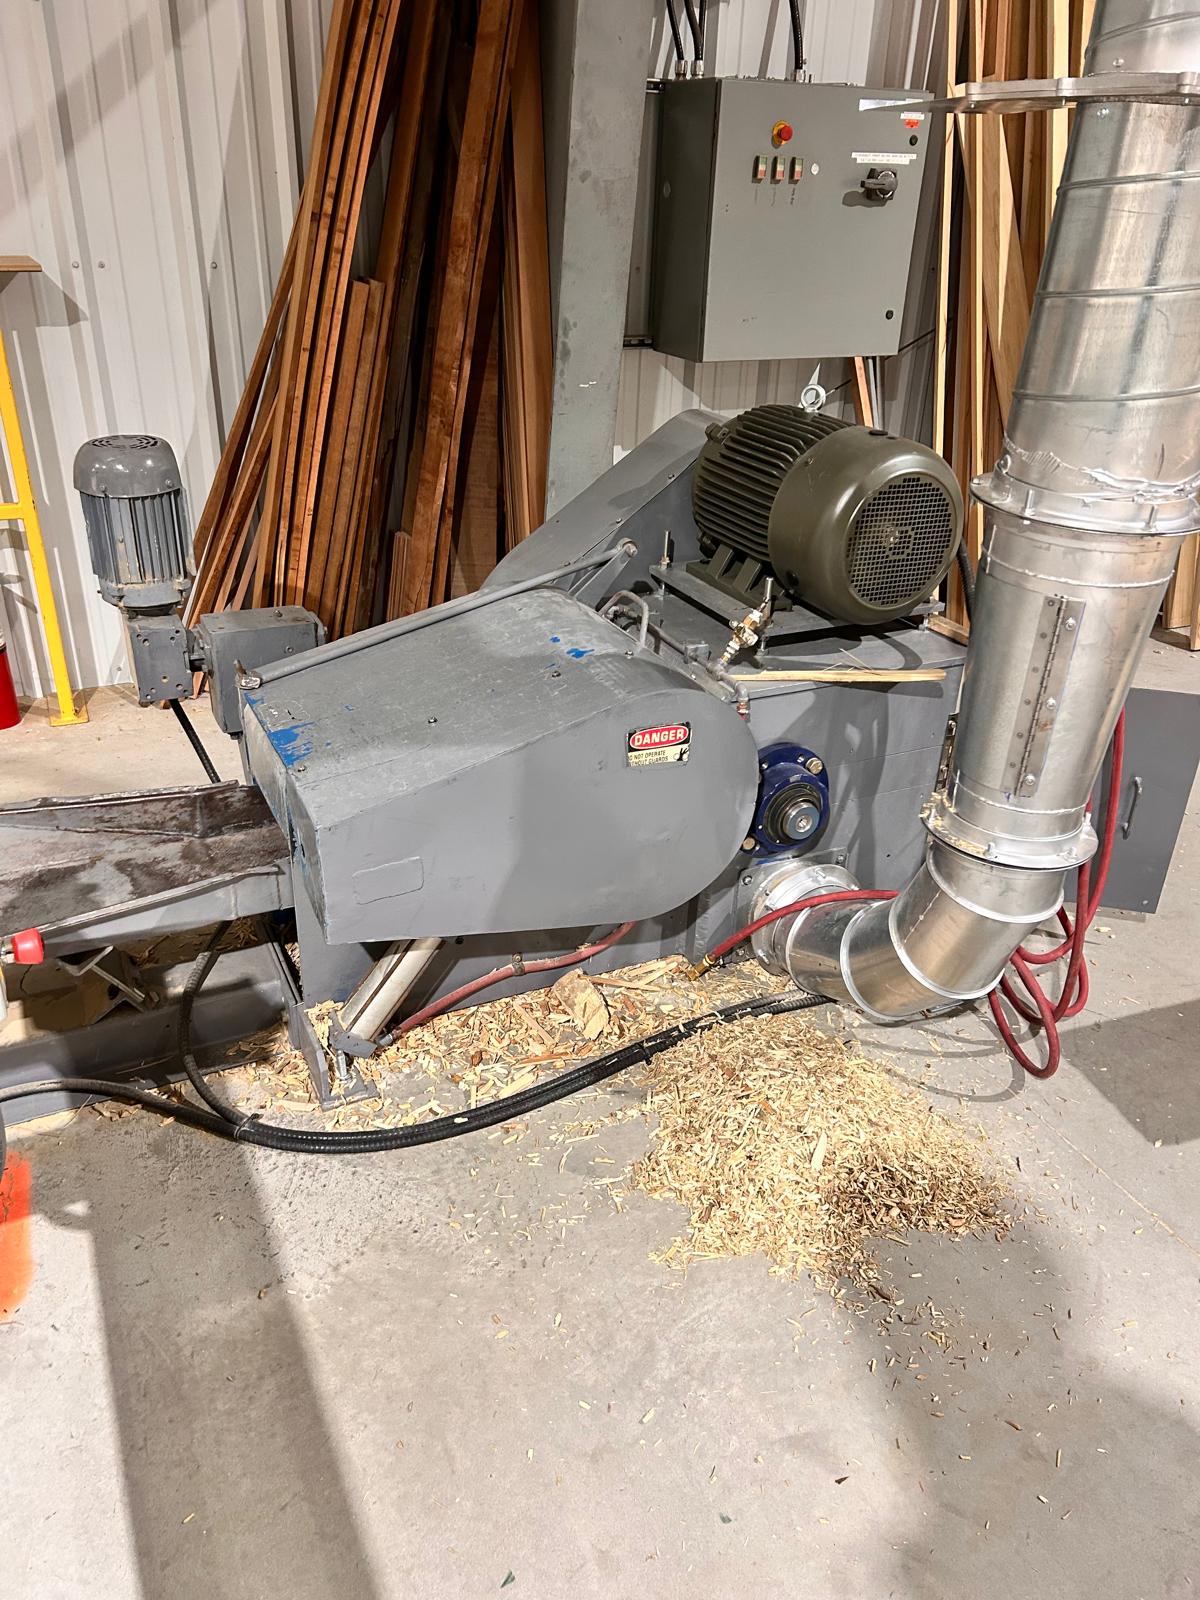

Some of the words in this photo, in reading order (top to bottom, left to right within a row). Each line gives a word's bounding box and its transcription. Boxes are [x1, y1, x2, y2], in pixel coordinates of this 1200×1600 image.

[634, 728, 685, 746] DANGER
[645, 750, 666, 758] OPERATE
[648, 756, 669, 764] GUARDS
